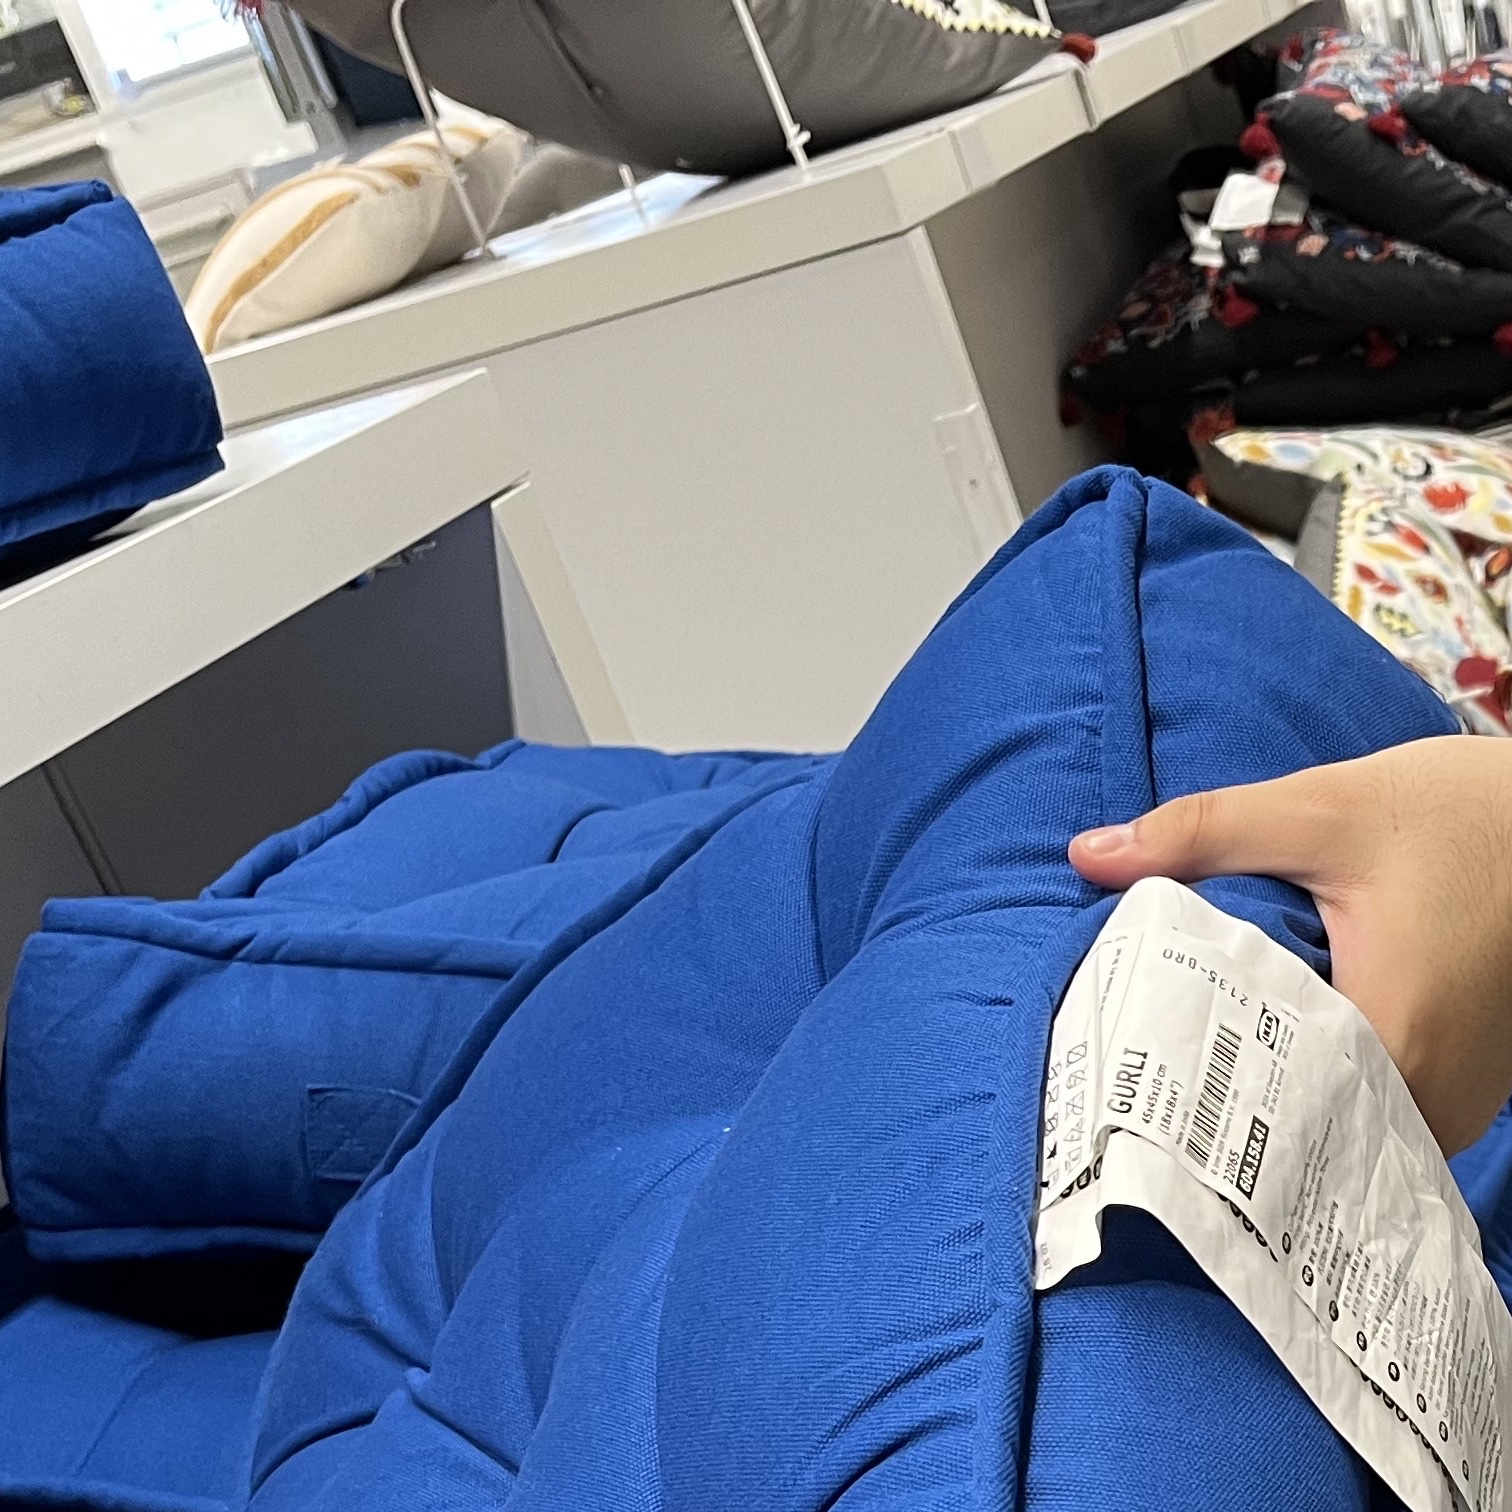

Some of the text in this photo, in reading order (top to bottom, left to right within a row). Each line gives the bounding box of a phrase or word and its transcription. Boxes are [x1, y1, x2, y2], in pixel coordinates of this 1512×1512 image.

[1106, 1047, 1148, 1114] GURLI
[1223, 1148, 1241, 1186] 22065
[1238, 1121, 1267, 1194] 604.158.41
